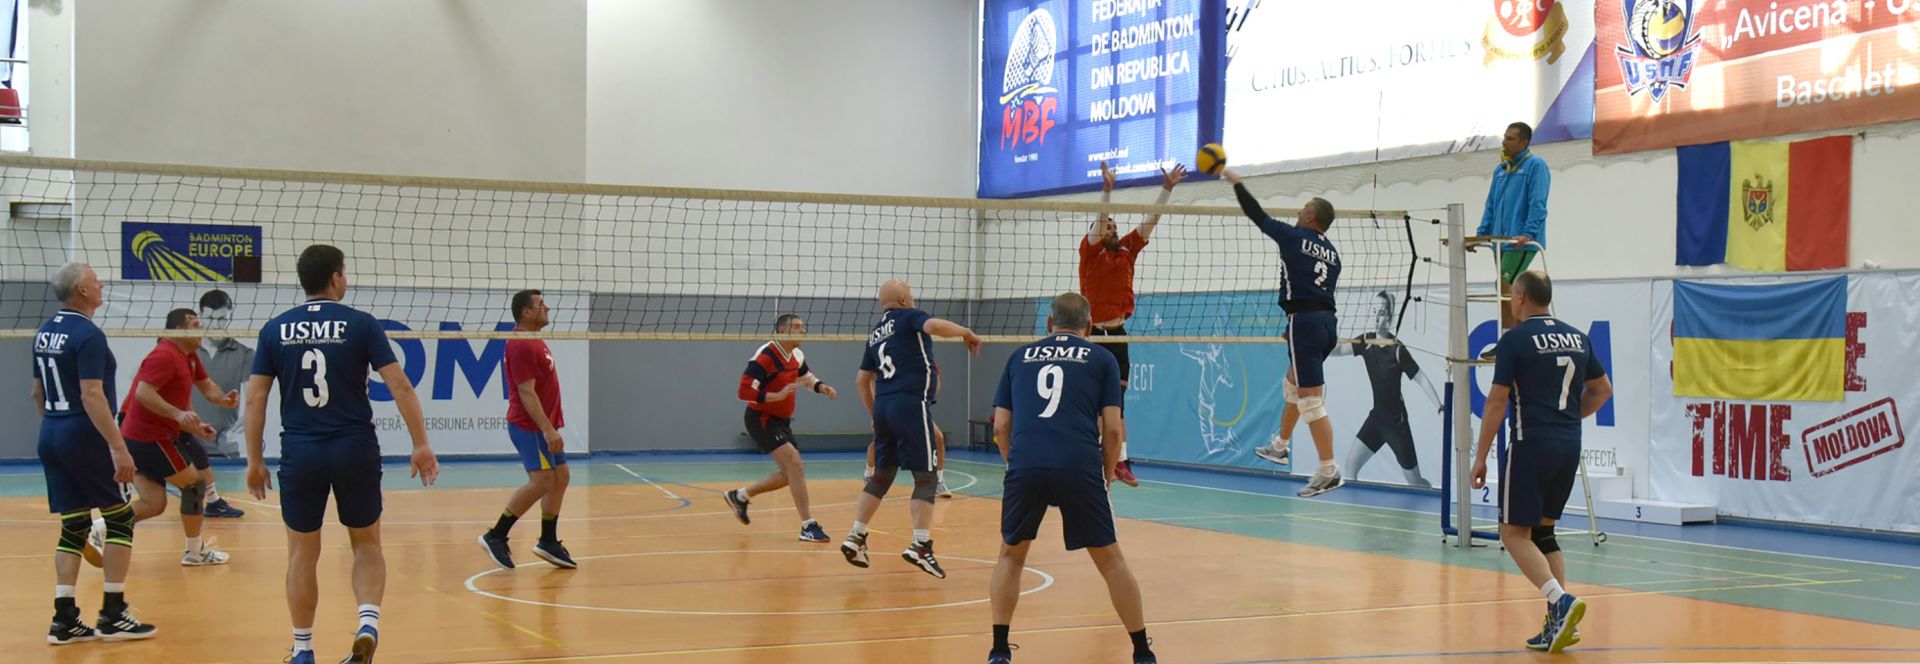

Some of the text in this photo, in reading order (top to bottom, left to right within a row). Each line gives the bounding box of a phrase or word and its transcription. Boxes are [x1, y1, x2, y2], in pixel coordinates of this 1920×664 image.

[1092, 13, 1194, 56] DE BADMINTON
[1091, 50, 1190, 90] DIN REPUBLICA
[1622, 51, 1694, 86] USMF
[1776, 62, 1896, 109] Baschet
[1001, 96, 1058, 152] MBF
[1090, 91, 1156, 123] MOLDOVA
[189, 232, 253, 243] BADMINTON
[189, 243, 253, 257] EUROPE
[1301, 239, 1337, 263] USMF
[280, 320, 348, 341] USMF
[1531, 332, 1583, 350] USMF
[878, 341, 896, 379] 6
[1023, 346, 1092, 361] USMF
[36, 356, 70, 411] 11
[301, 348, 330, 408] 3
[1036, 363, 1064, 418] 9
[1127, 363, 1155, 392] TECT
[1556, 355, 1576, 411] 7
[421, 416, 475, 431] ERSIUNEA
[1685, 400, 1792, 482] TIME
[1812, 411, 1892, 464] MOLDOVA
[1482, 486, 1490, 503] 2
[1635, 506, 1642, 519] 3
